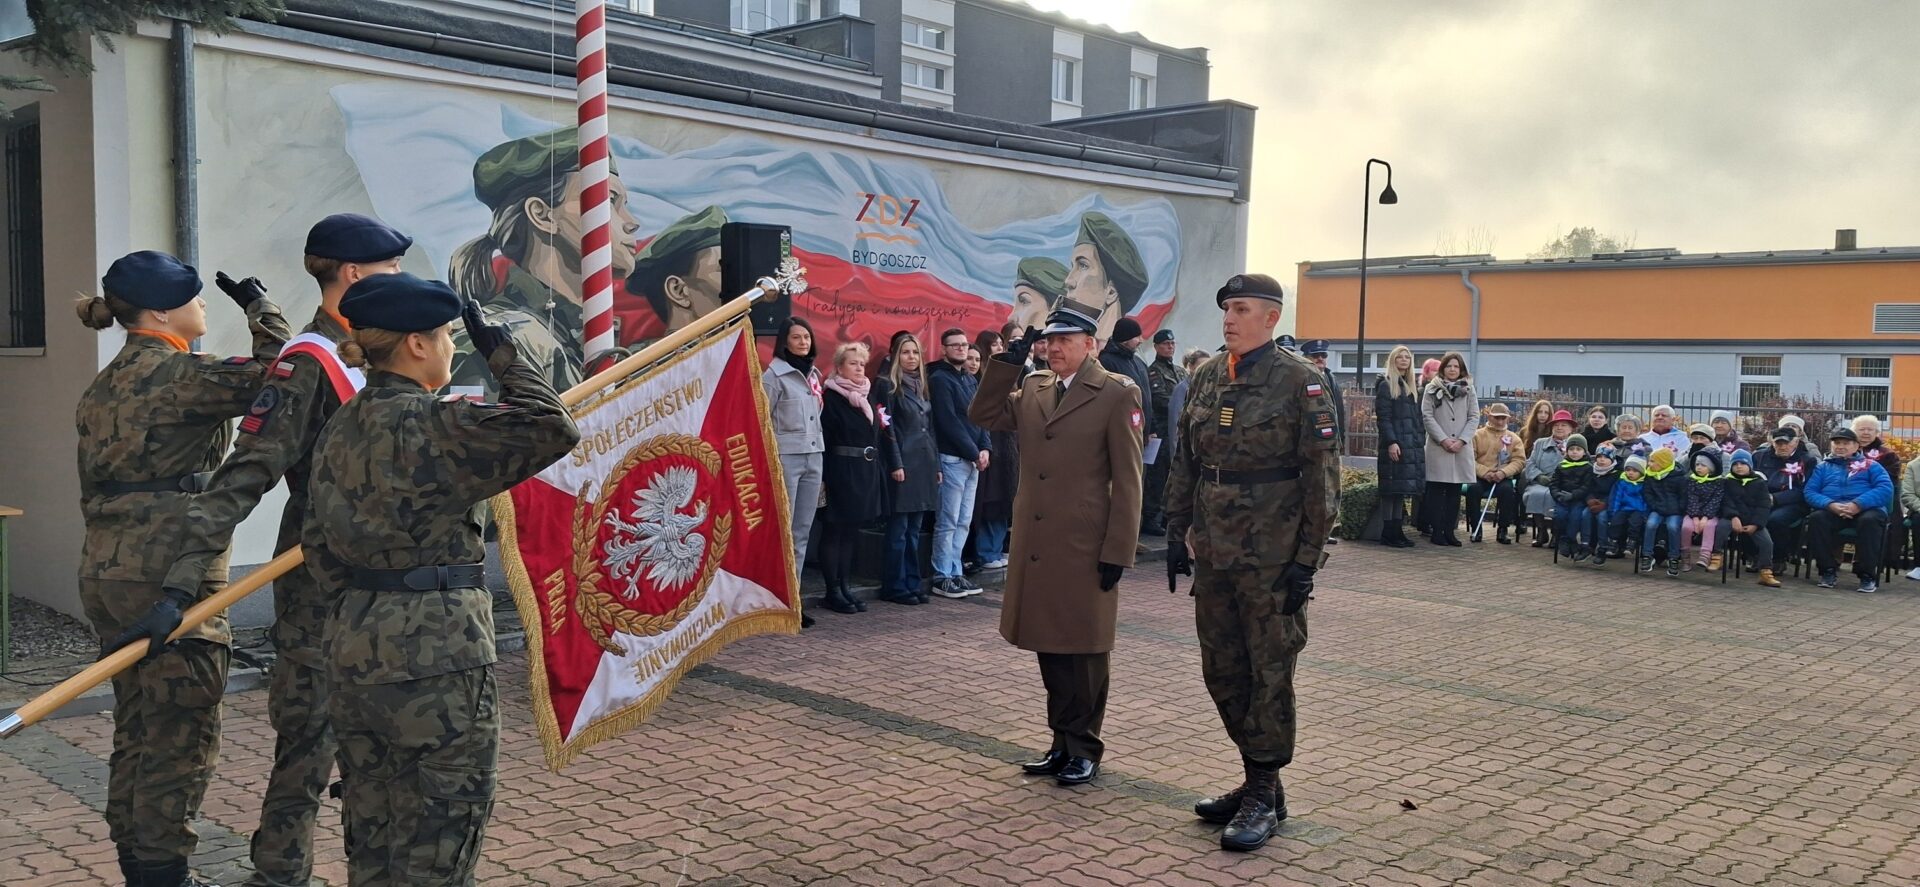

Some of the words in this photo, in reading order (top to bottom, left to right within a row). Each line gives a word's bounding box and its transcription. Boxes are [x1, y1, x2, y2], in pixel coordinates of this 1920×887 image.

[856, 192, 921, 229] ZDZ
[852, 250, 927, 269] BYDGOSZCZ
[798, 287, 866, 327] Tradycja
[726, 432, 763, 531] EDUKACJA
[543, 568, 567, 636] PRACA
[631, 602, 726, 684] WYCHOWANIE
